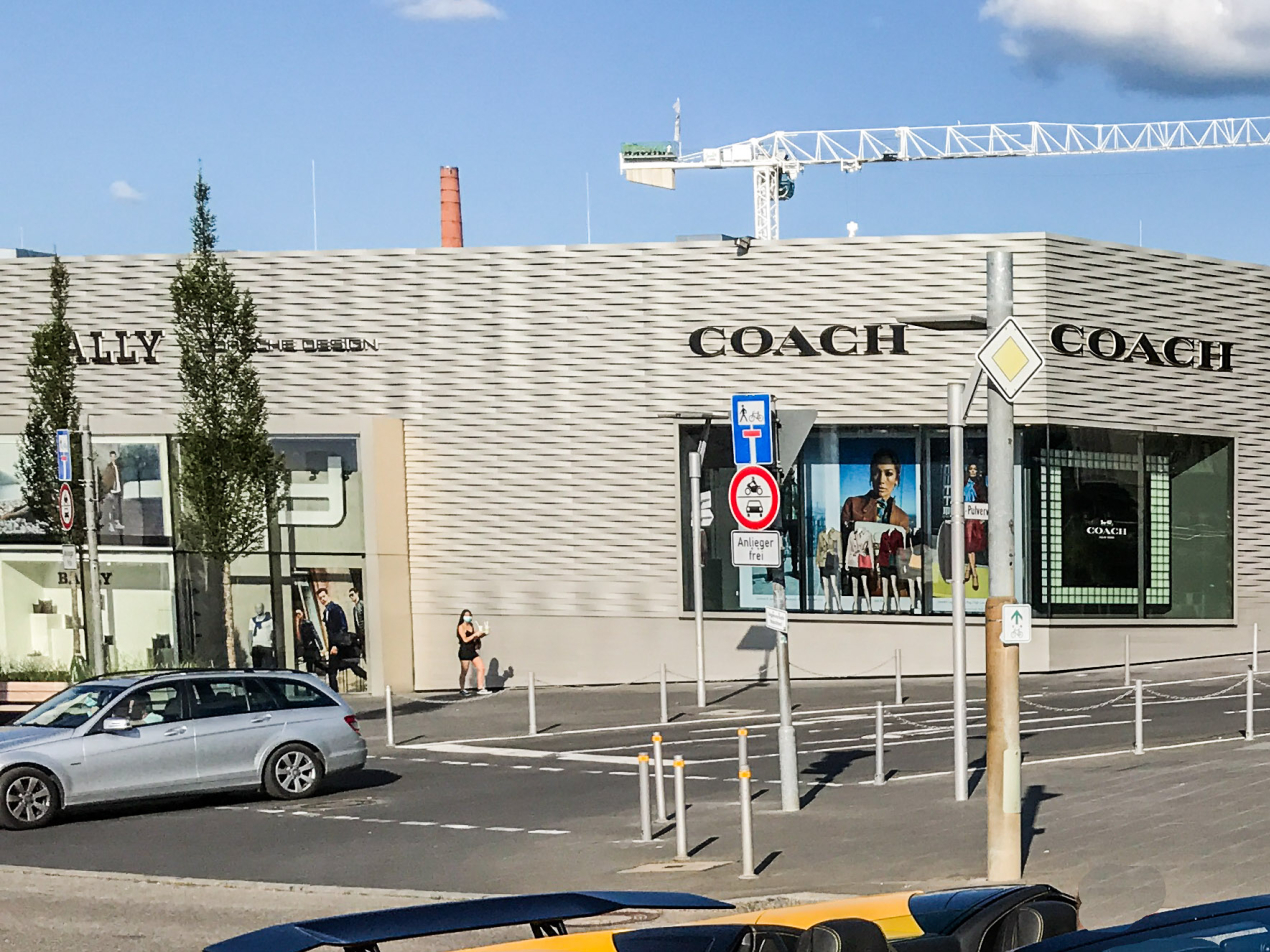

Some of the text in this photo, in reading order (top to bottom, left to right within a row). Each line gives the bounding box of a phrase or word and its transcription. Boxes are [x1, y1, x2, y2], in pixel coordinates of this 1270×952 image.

[69, 330, 165, 365] ALLY
[301, 338, 379, 352] DESIGN
[688, 324, 910, 357] COACH
[1049, 323, 1236, 373] COACH
[1086, 526, 1127, 535] COACH
[737, 537, 774, 550] Anlieger
[748, 550, 764, 561] frei
